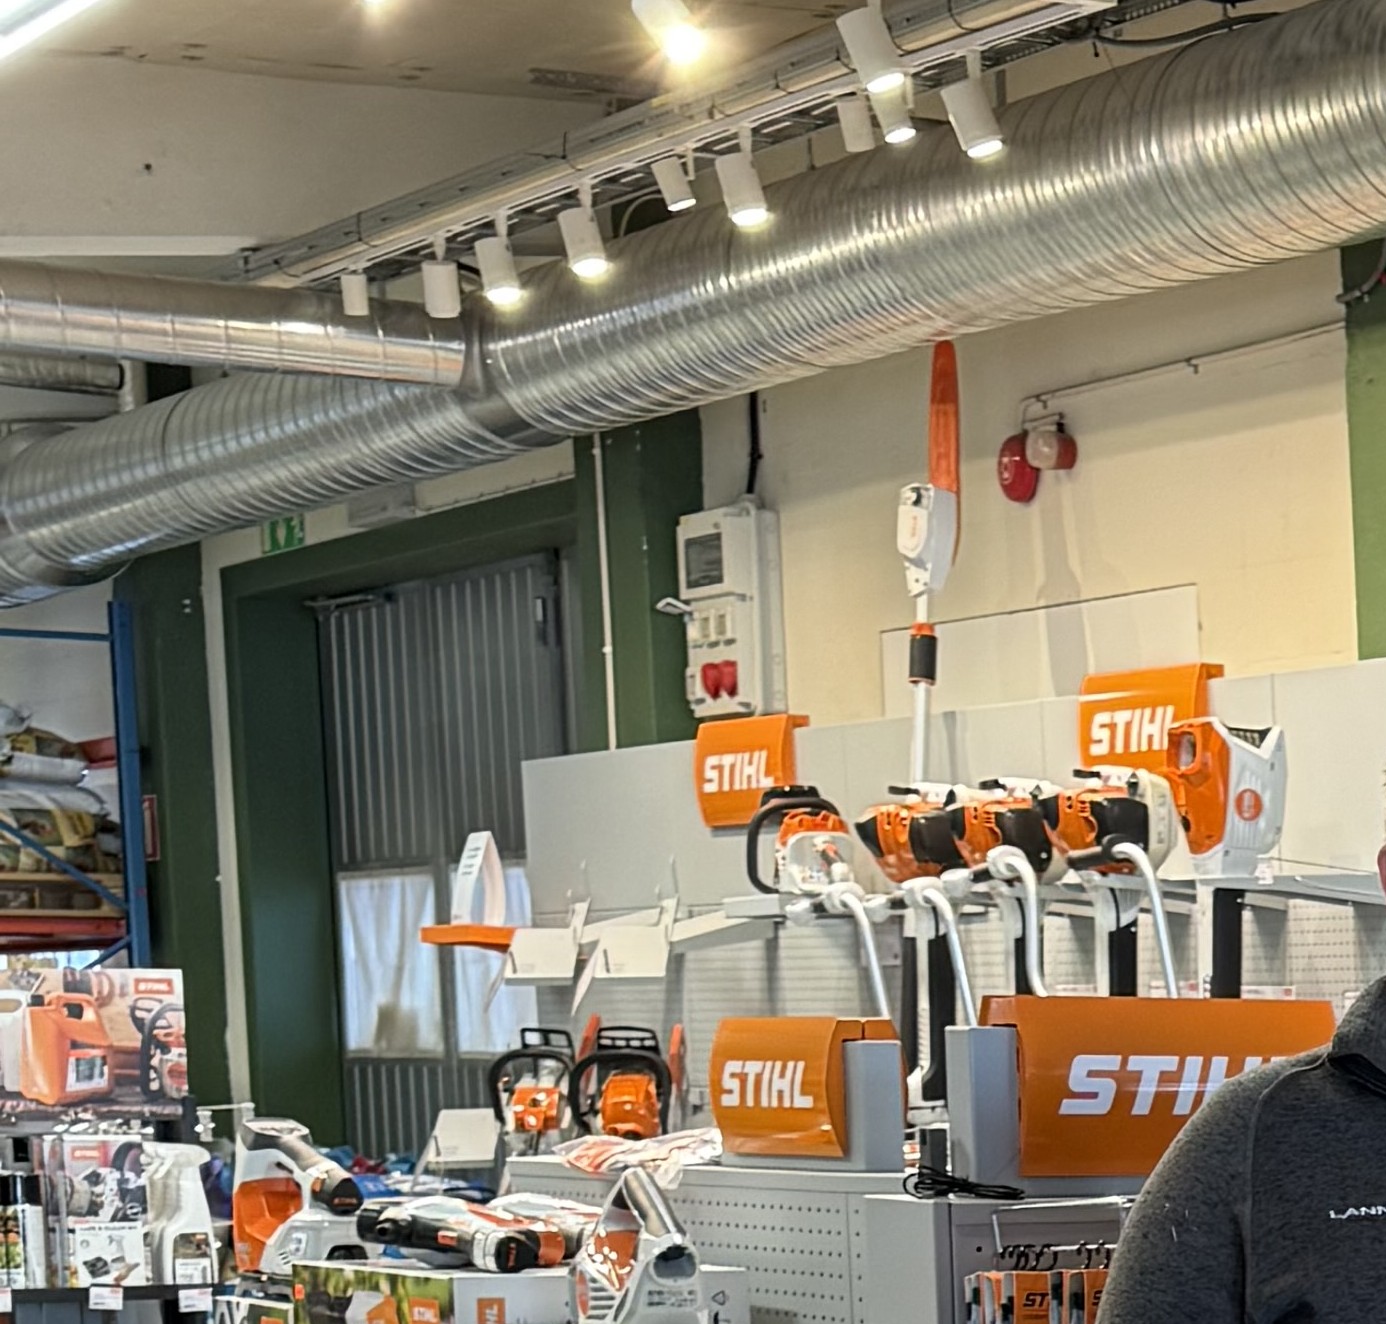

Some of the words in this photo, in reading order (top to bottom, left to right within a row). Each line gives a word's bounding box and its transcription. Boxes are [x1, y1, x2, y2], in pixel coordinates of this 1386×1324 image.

[1089, 705, 1175, 757] STIHL
[703, 749, 774, 794] STIHL
[720, 1060, 814, 1110] STIHL
[1058, 1054, 1287, 1116] STI
